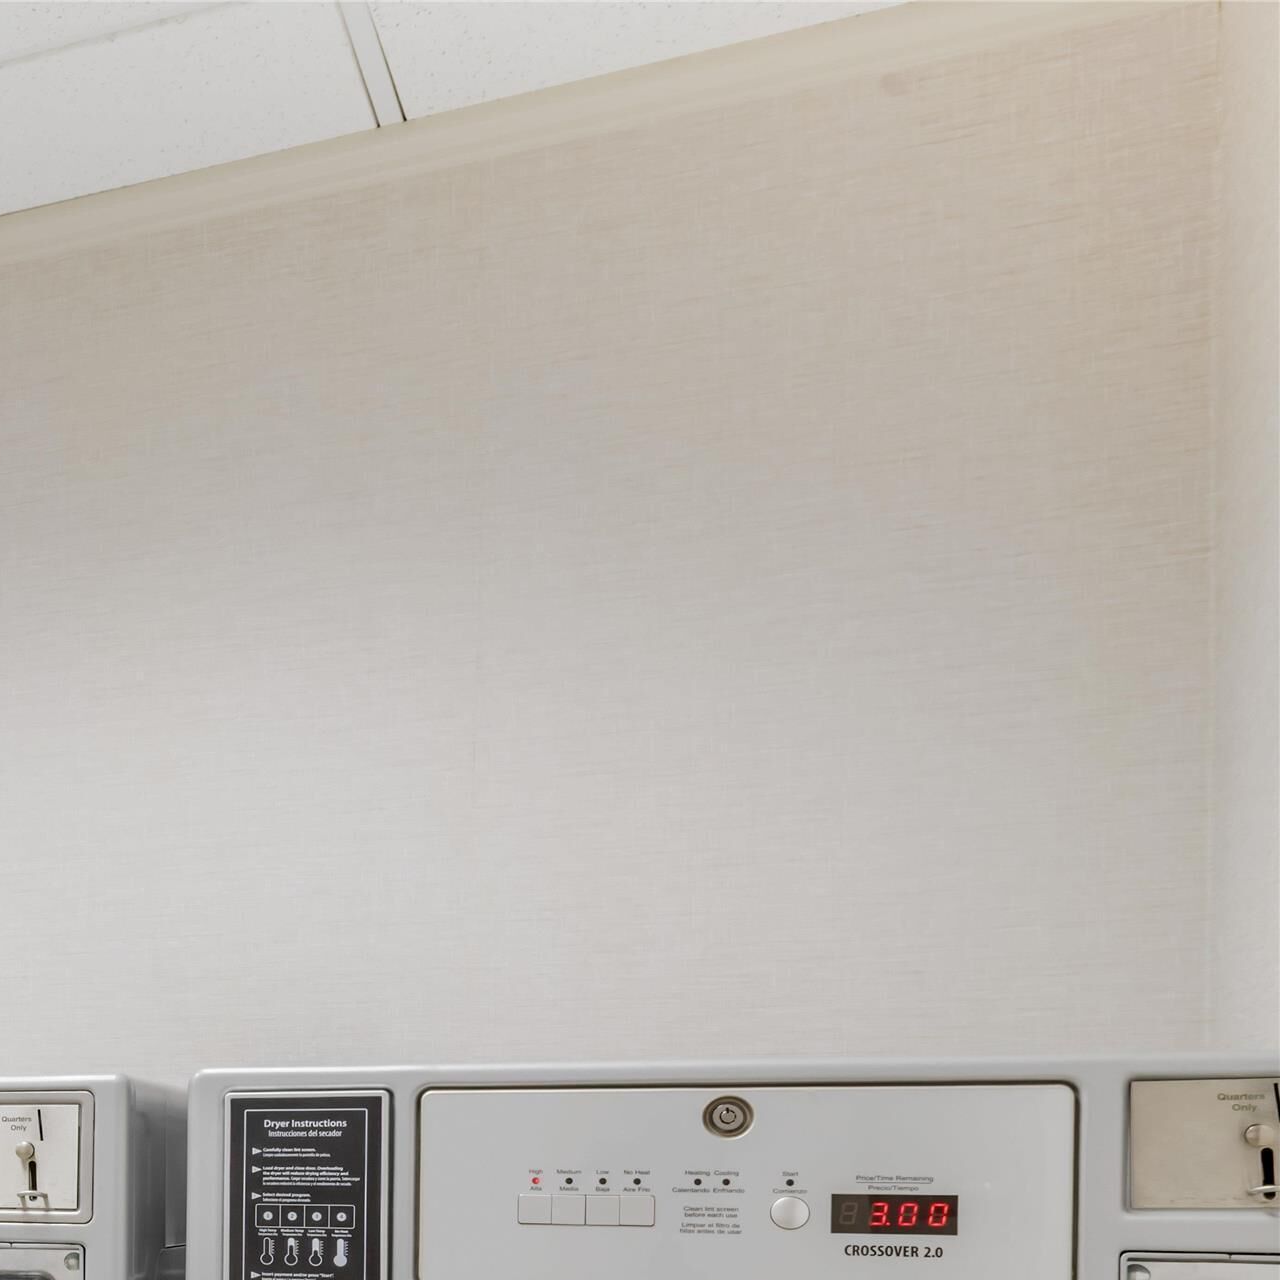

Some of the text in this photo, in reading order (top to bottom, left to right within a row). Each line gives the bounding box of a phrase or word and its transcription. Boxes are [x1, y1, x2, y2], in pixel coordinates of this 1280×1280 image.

[1217, 1093, 1265, 1101] Quarters
[1232, 1104, 1257, 1112] Only
[264, 1119, 347, 1129] Dryer Instructions
[869, 1202, 949, 1227] 3.00
[844, 1245, 943, 1258] CROSSOVER 2.0
